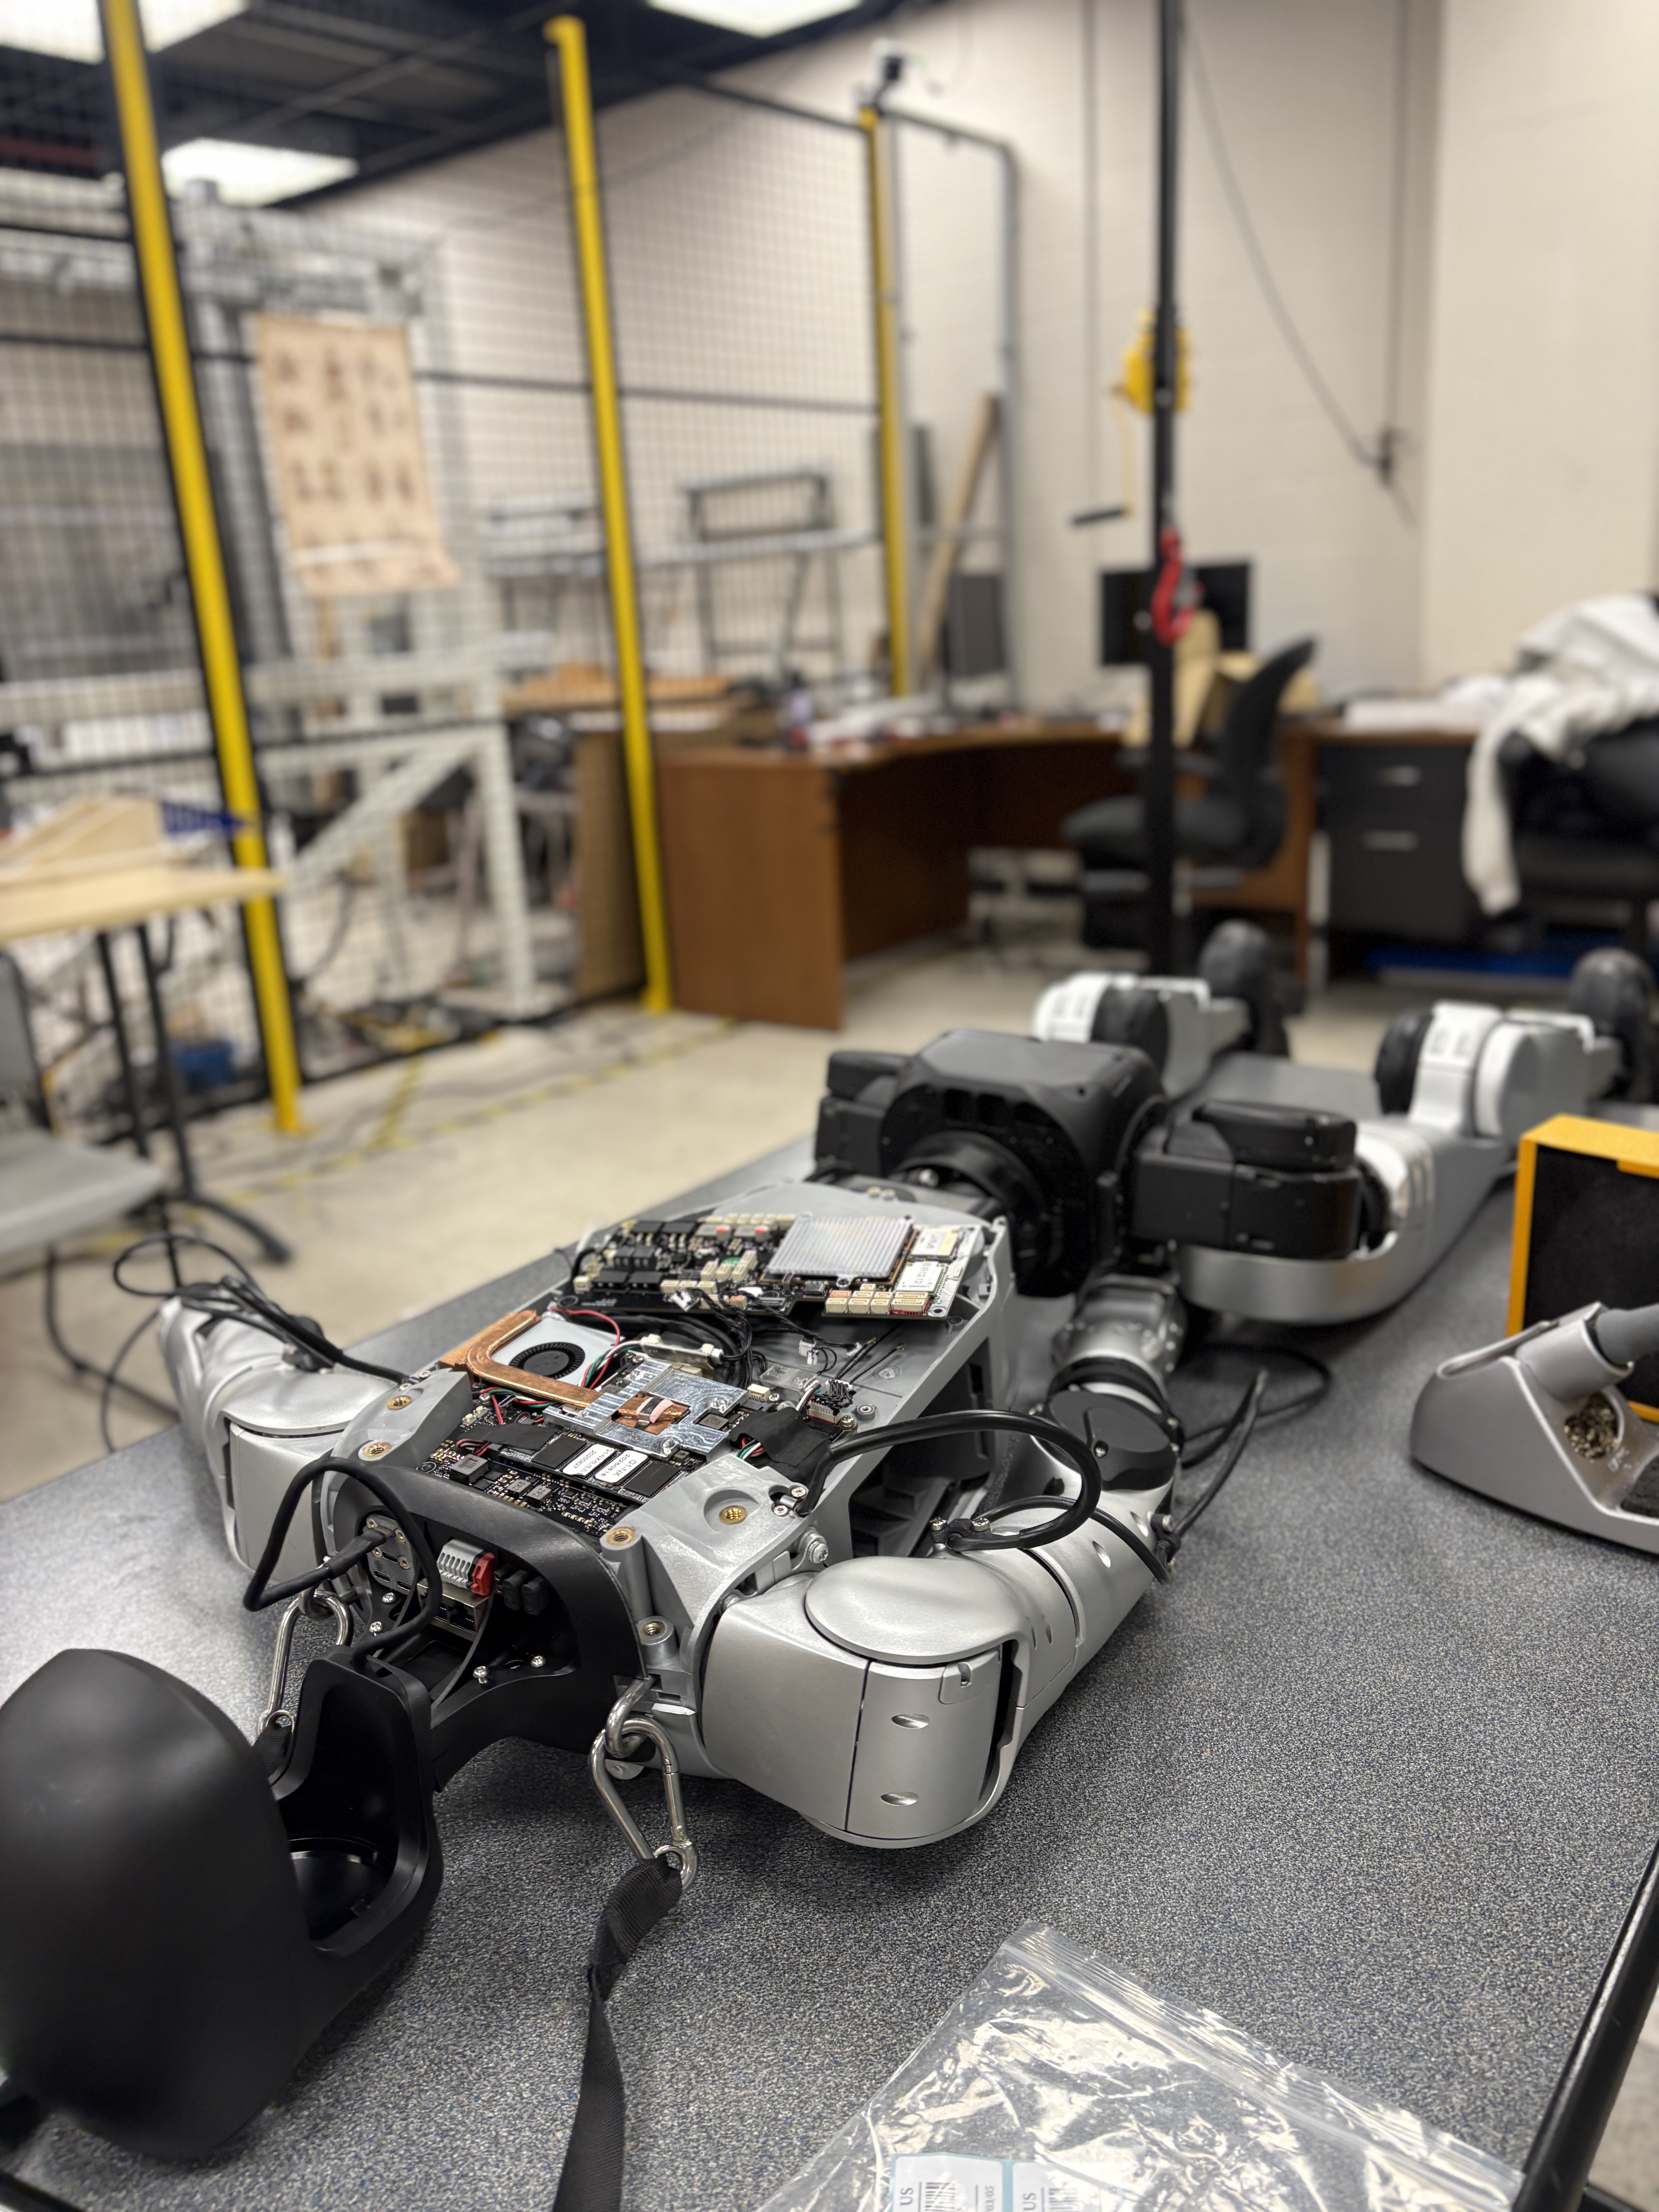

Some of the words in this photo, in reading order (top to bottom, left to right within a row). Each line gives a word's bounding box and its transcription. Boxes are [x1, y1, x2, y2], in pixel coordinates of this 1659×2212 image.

[613, 1460, 637, 1477] G1-NX
[900, 2187, 914, 2206] US
[1023, 2192, 1036, 2211] US
